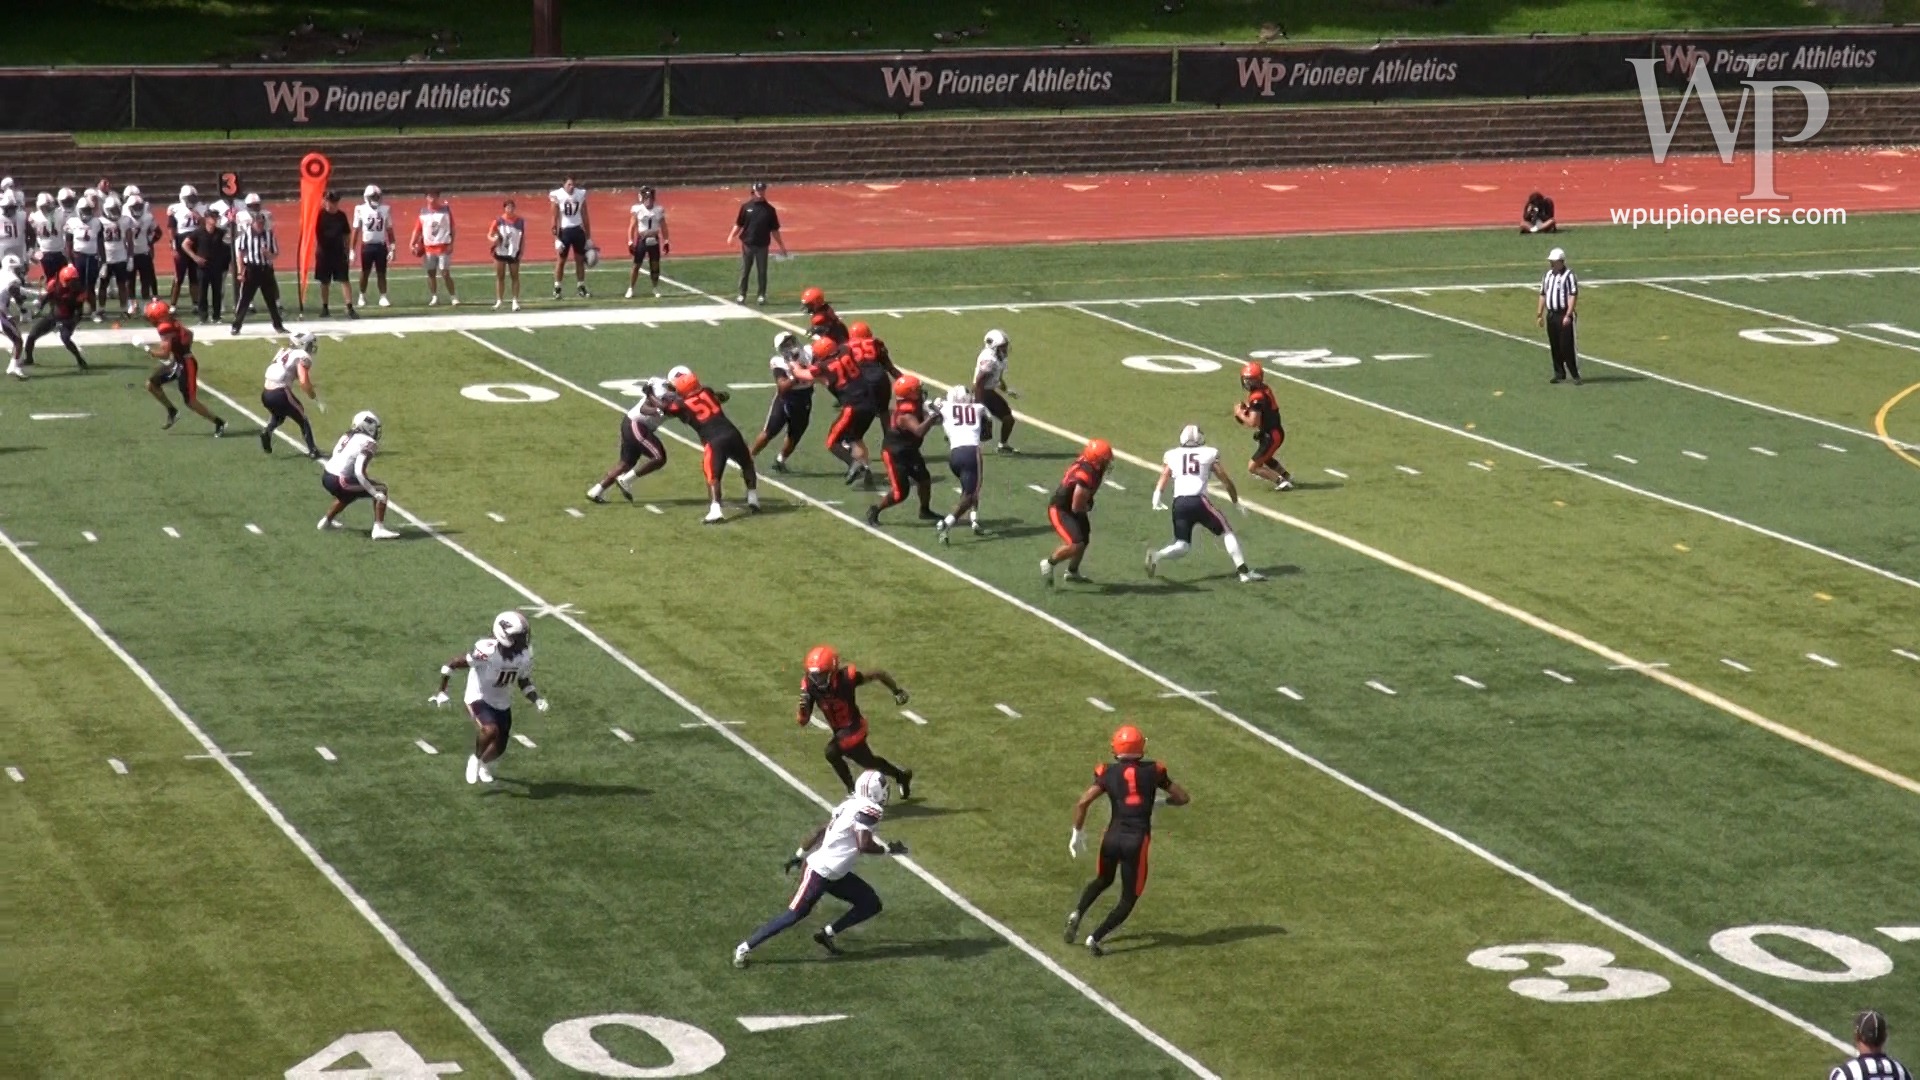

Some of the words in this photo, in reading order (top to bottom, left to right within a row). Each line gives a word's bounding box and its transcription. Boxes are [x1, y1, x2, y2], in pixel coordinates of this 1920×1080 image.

[1713, 49, 1790, 73] Pioneer
[1791, 44, 1878, 70] Athletics
[881, 67, 932, 106] WP
[937, 69, 1020, 94] Pioneer
[1022, 67, 1113, 92] Athletics
[1236, 57, 1287, 96] WP
[1288, 62, 1370, 86] Pioneer
[1371, 57, 1458, 84] Athletics
[263, 81, 320, 122] WP
[324, 85, 412, 112] Pioneer
[415, 83, 511, 108] Athletics
[221, 172, 237, 196] 3
[849, 337, 876, 363] 55
[684, 389, 721, 423] 51
[952, 405, 977, 426] 90
[1182, 453, 1201, 476] 15
[1123, 766, 1143, 806] 1
